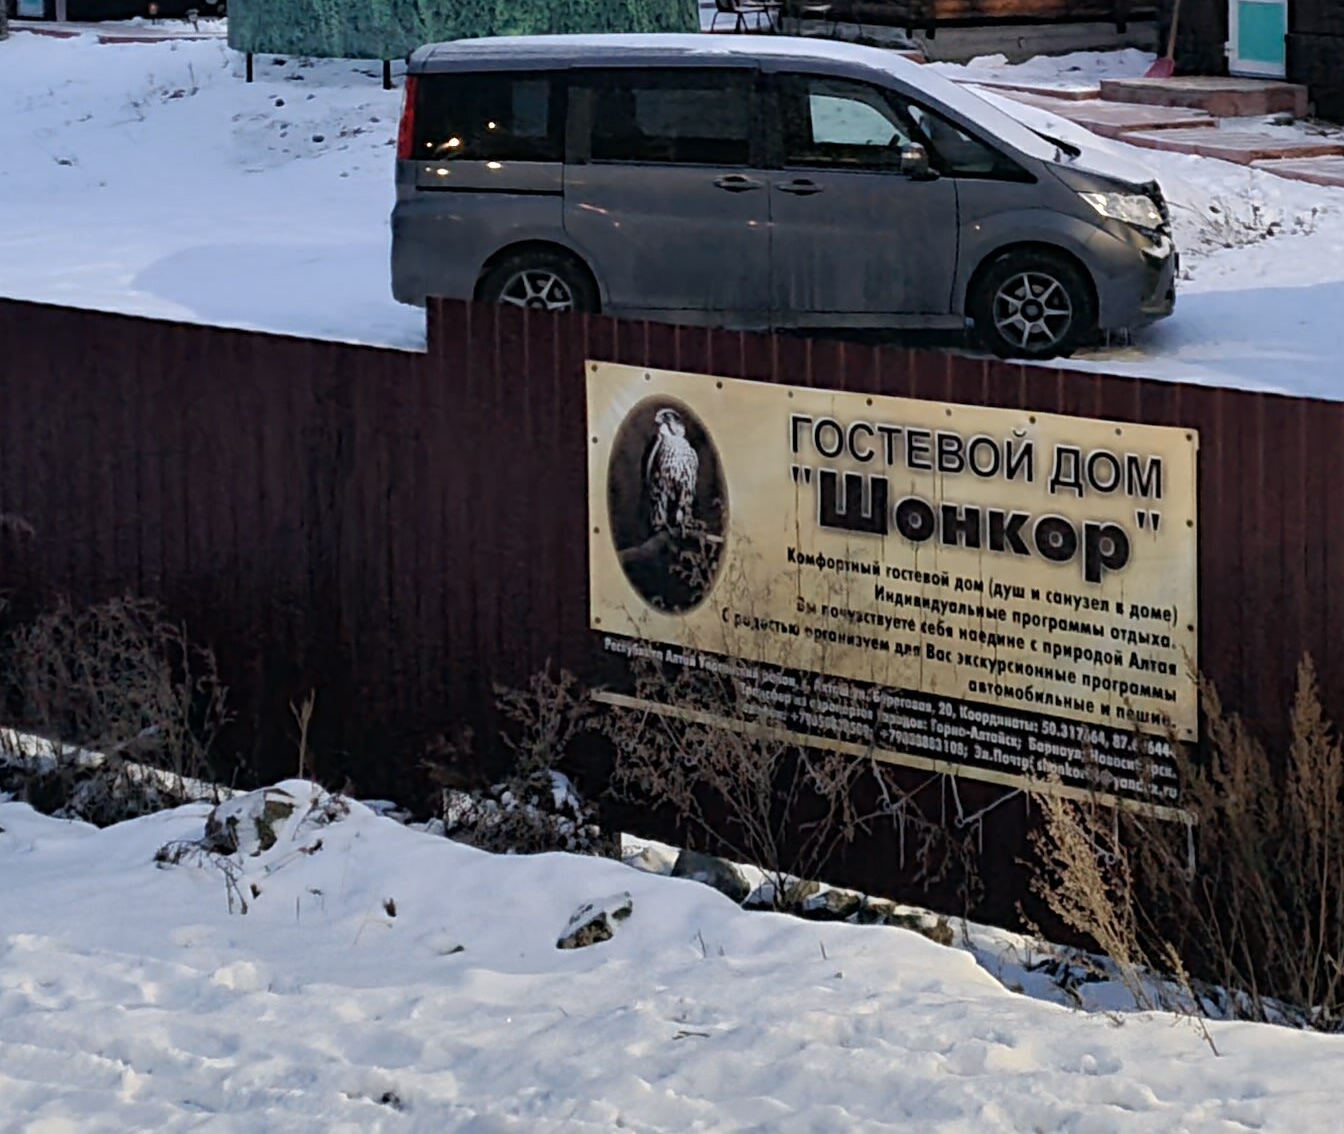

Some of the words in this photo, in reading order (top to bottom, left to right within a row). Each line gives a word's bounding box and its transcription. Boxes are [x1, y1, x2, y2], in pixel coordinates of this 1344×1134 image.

[791, 414, 1034, 483] ГОСТЕВОЙ
[1049, 445, 1162, 499] ДОМ
[791, 466, 1161, 584] "Шонкор"
[787, 547, 881, 576] Комфортный
[886, 565, 949, 587] гостевой
[954, 576, 984, 592] дом
[989, 576, 1026, 601] (душ
[1031, 588, 1040, 601] и
[1046, 589, 1110, 612] санузел
[1115, 601, 1125, 615] в
[1129, 604, 1178, 628] доме)
[874, 583, 1007, 621] Индивидуальные
[1012, 610, 1105, 637] программы
[796, 596, 817, 616] Вы
[821, 603, 916, 632] почувствуете
[920, 619, 954, 638] себя
[958, 627, 1025, 650] наедине
[1030, 638, 1038, 652] с
[1042, 640, 1124, 666] природой
[1128, 651, 1177, 676] Алтая
[804, 627, 890, 652] организуем
[894, 641, 921, 657] для
[926, 643, 953, 663] Вас
[957, 651, 1077, 685] экскурсионные
[1082, 673, 1177, 703] программы
[959, 704, 1040, 733] Координаты:
[968, 679, 1095, 713] автомобильные
[1100, 702, 1111, 716] и
